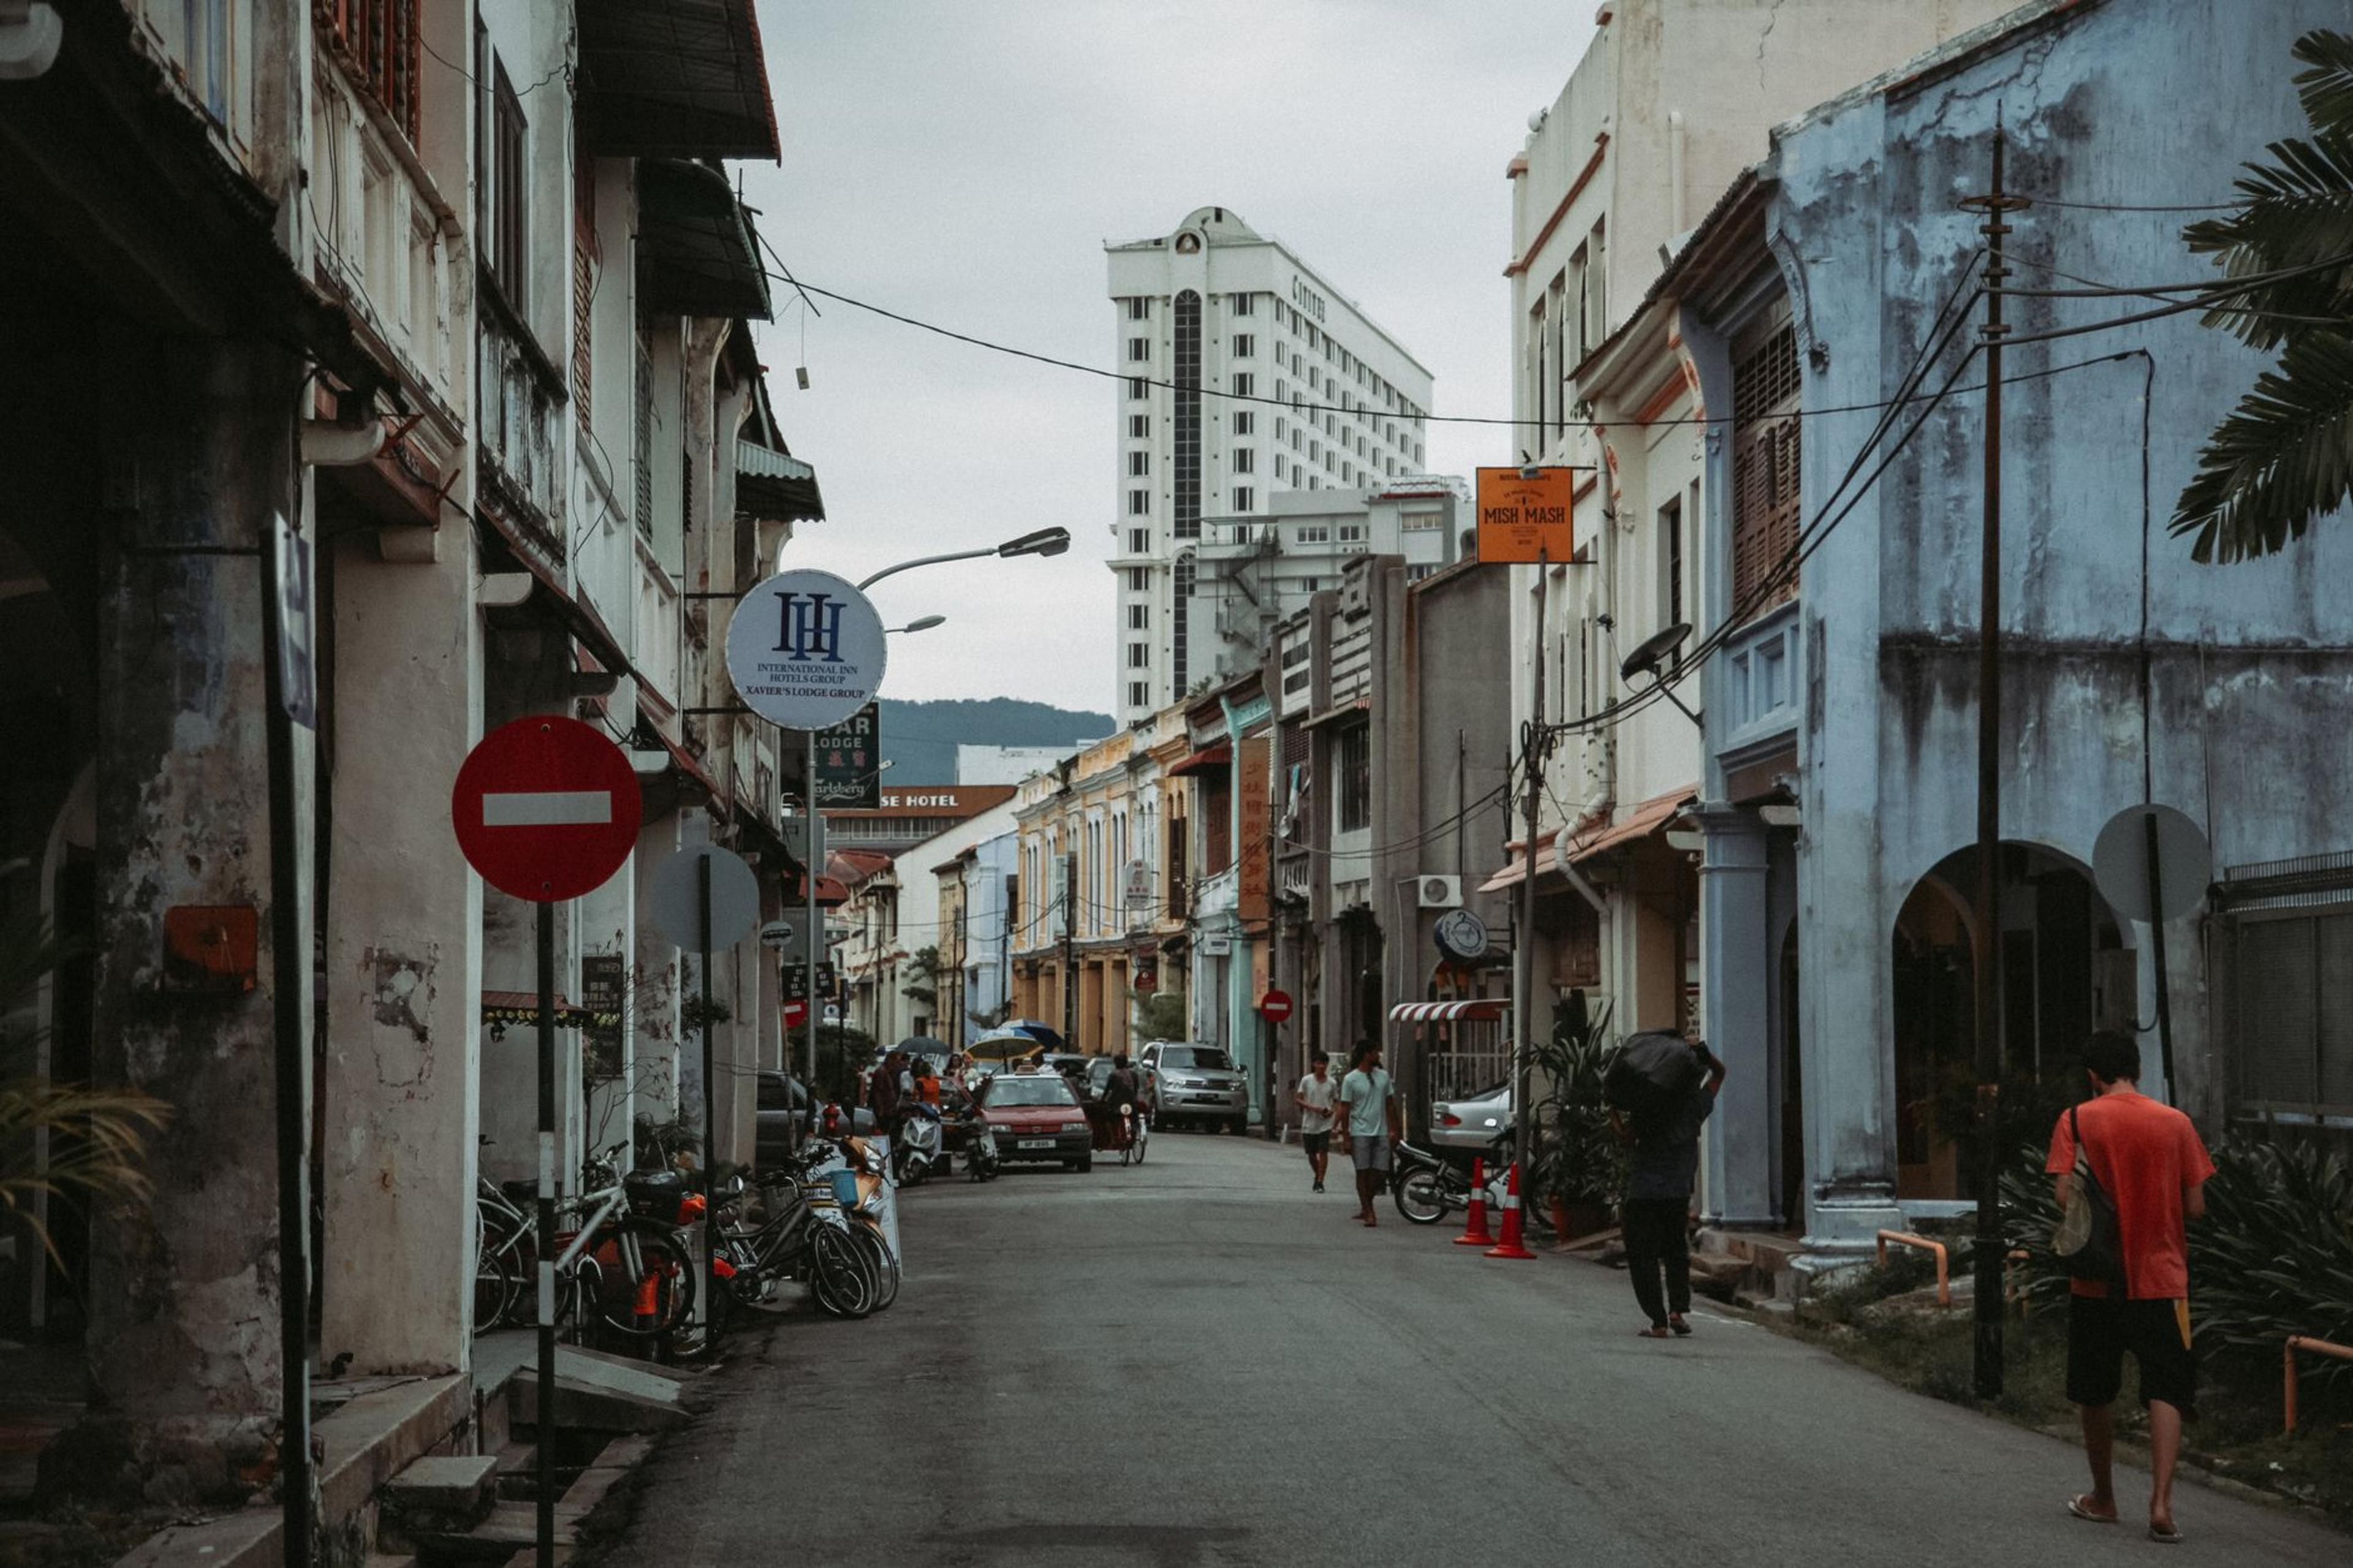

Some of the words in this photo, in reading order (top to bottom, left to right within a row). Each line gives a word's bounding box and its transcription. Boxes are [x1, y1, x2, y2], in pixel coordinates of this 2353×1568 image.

[1484, 507, 1518, 524] MISH
[1525, 507, 1565, 524] MASH
[757, 663, 838, 674] INTERNATIONAL
[839, 665, 858, 674] INN
[770, 674, 809, 683] HOTELS
[810, 675, 846, 684] GROUP
[746, 686, 791, 696] XAVIER'S
[792, 687, 828, 697] LODGE
[829, 689, 865, 699] GROUP
[814, 781, 865, 797] arlsberg
[906, 795, 959, 807] HOTEL
